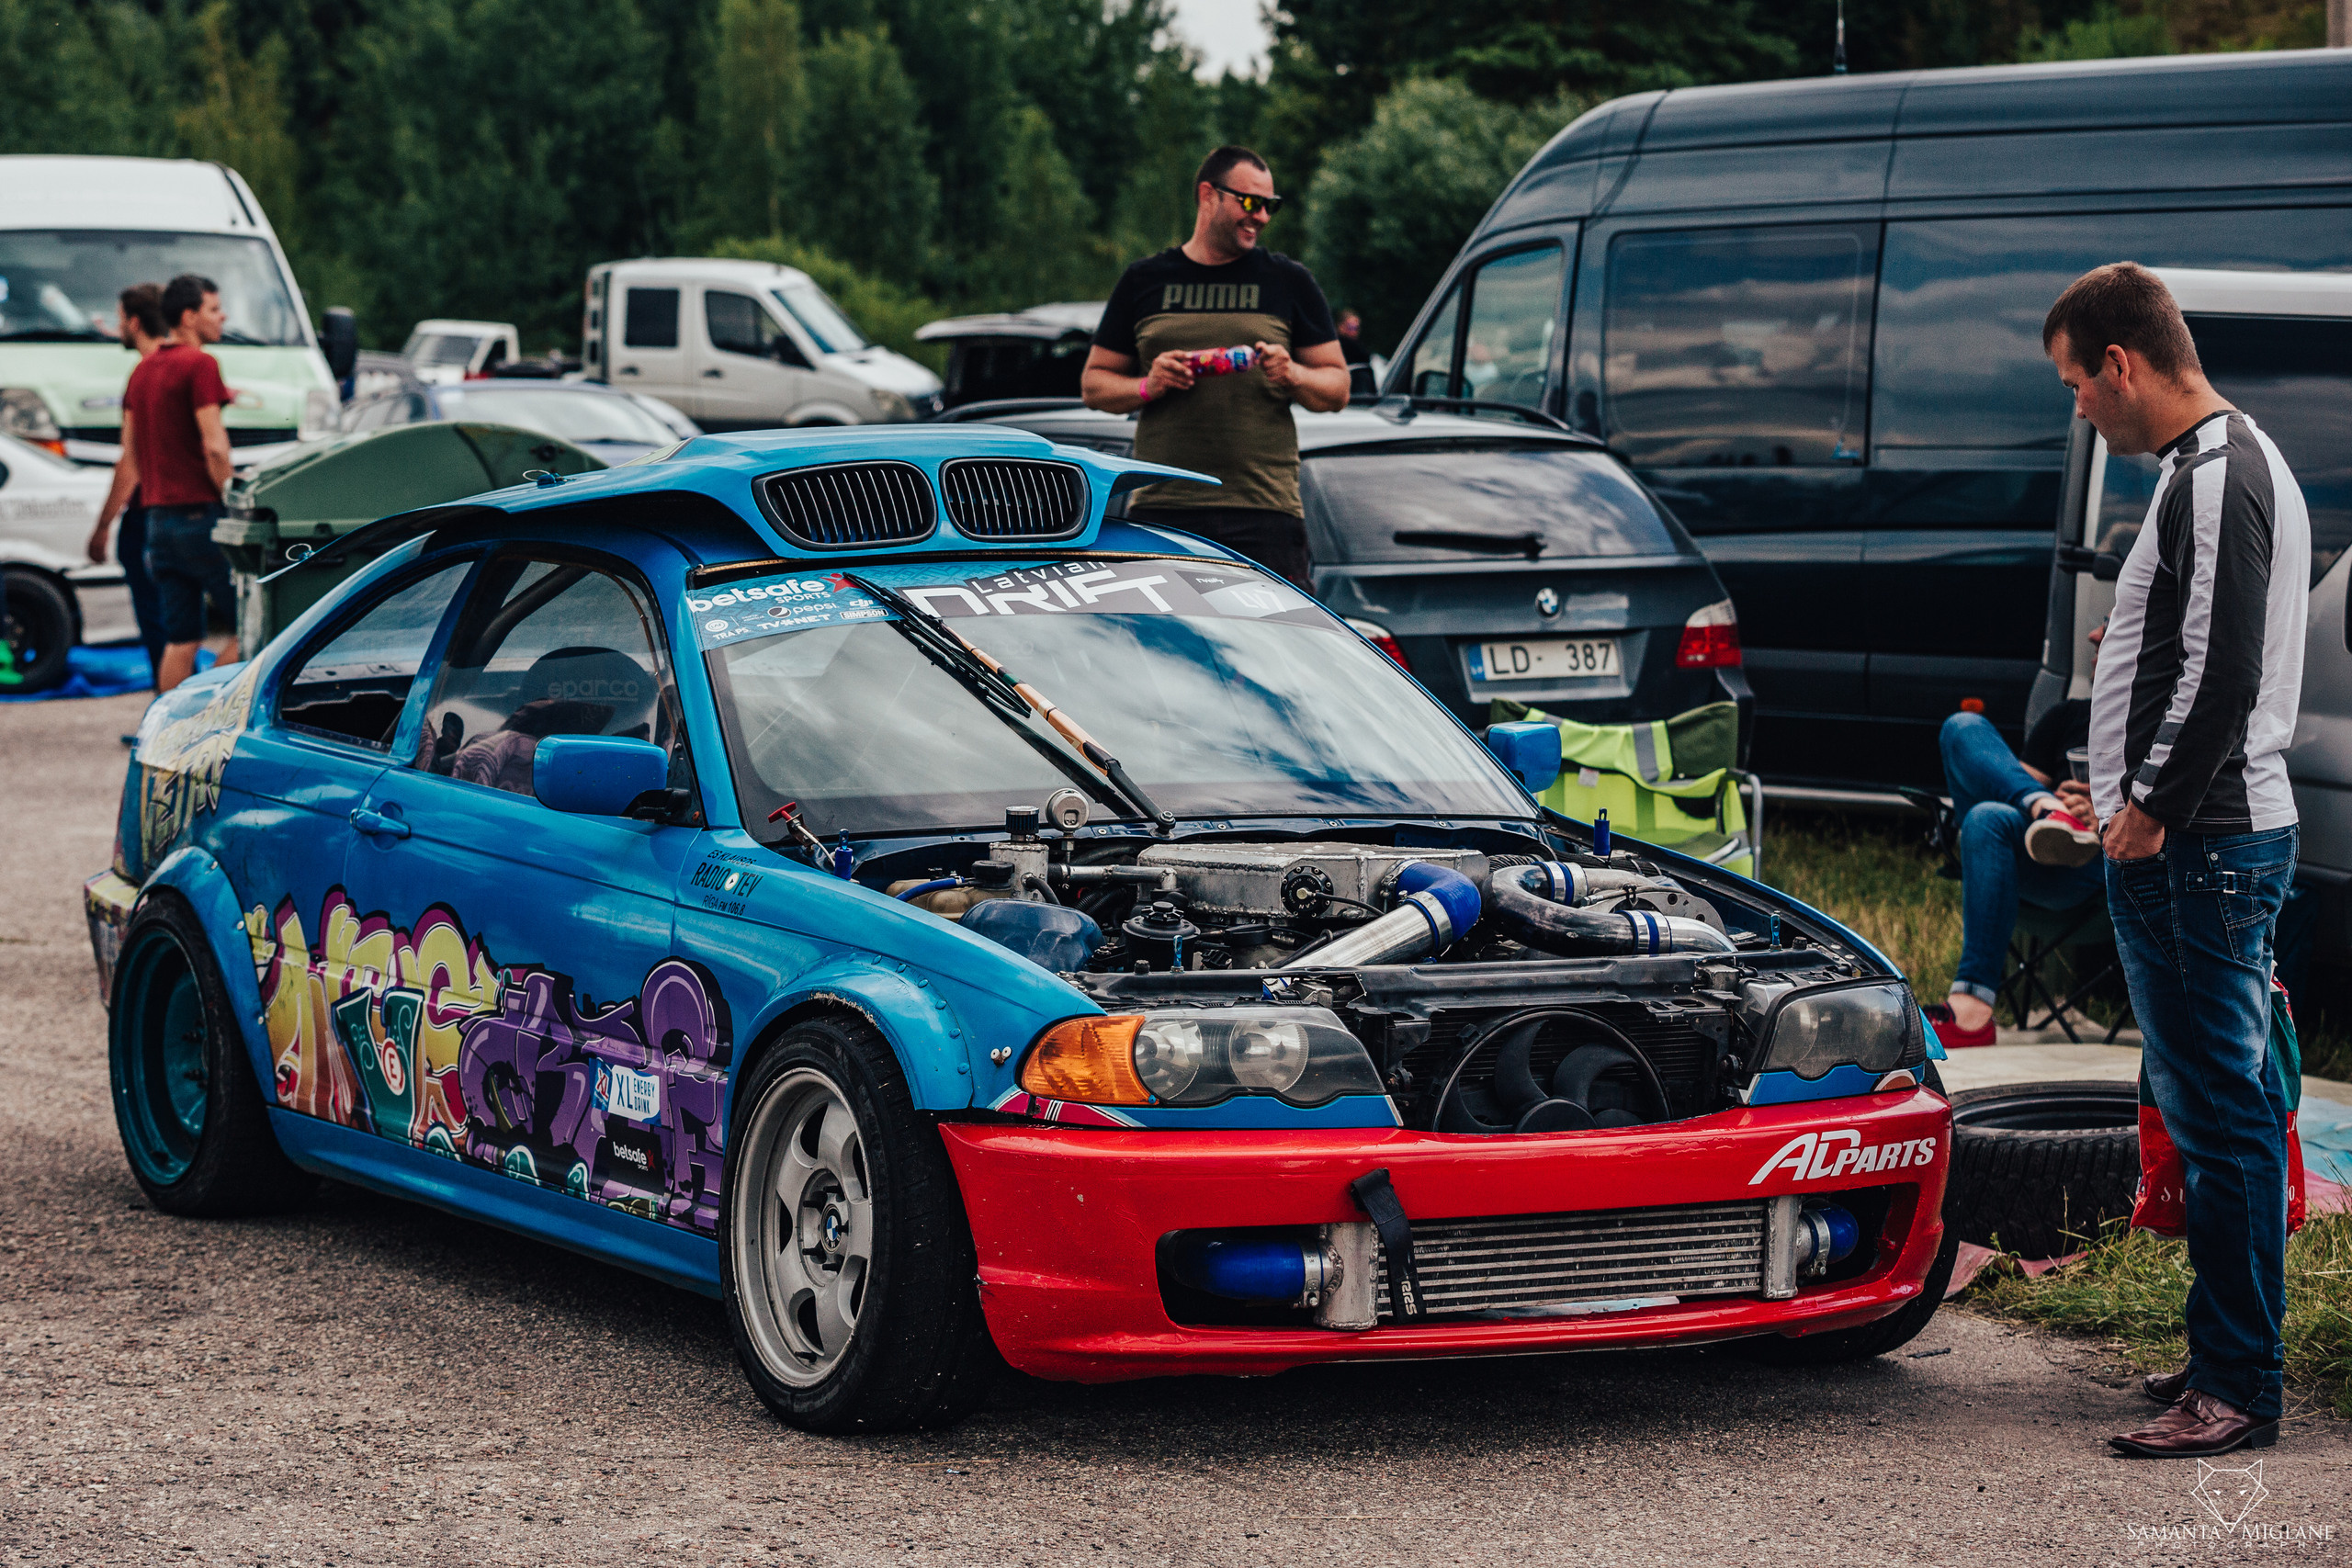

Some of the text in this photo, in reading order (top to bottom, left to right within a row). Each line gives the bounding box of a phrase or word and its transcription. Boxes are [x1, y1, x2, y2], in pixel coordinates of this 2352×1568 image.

[1162, 284, 1261, 310] PUMA
[687, 579, 826, 613] betsafe
[777, 591, 831, 604] SPORTS
[902, 570, 1174, 618] DRIFT
[842, 608, 887, 618] SIMPSON
[1566, 643, 1611, 671] 387
[548, 680, 639, 699] sparco
[691, 862, 764, 898] RADIO TEV
[616, 1073, 633, 1110] XL
[633, 1077, 656, 1099] ENERGY
[634, 1096, 651, 1115] DRINK
[613, 1141, 648, 1165] betsafe
